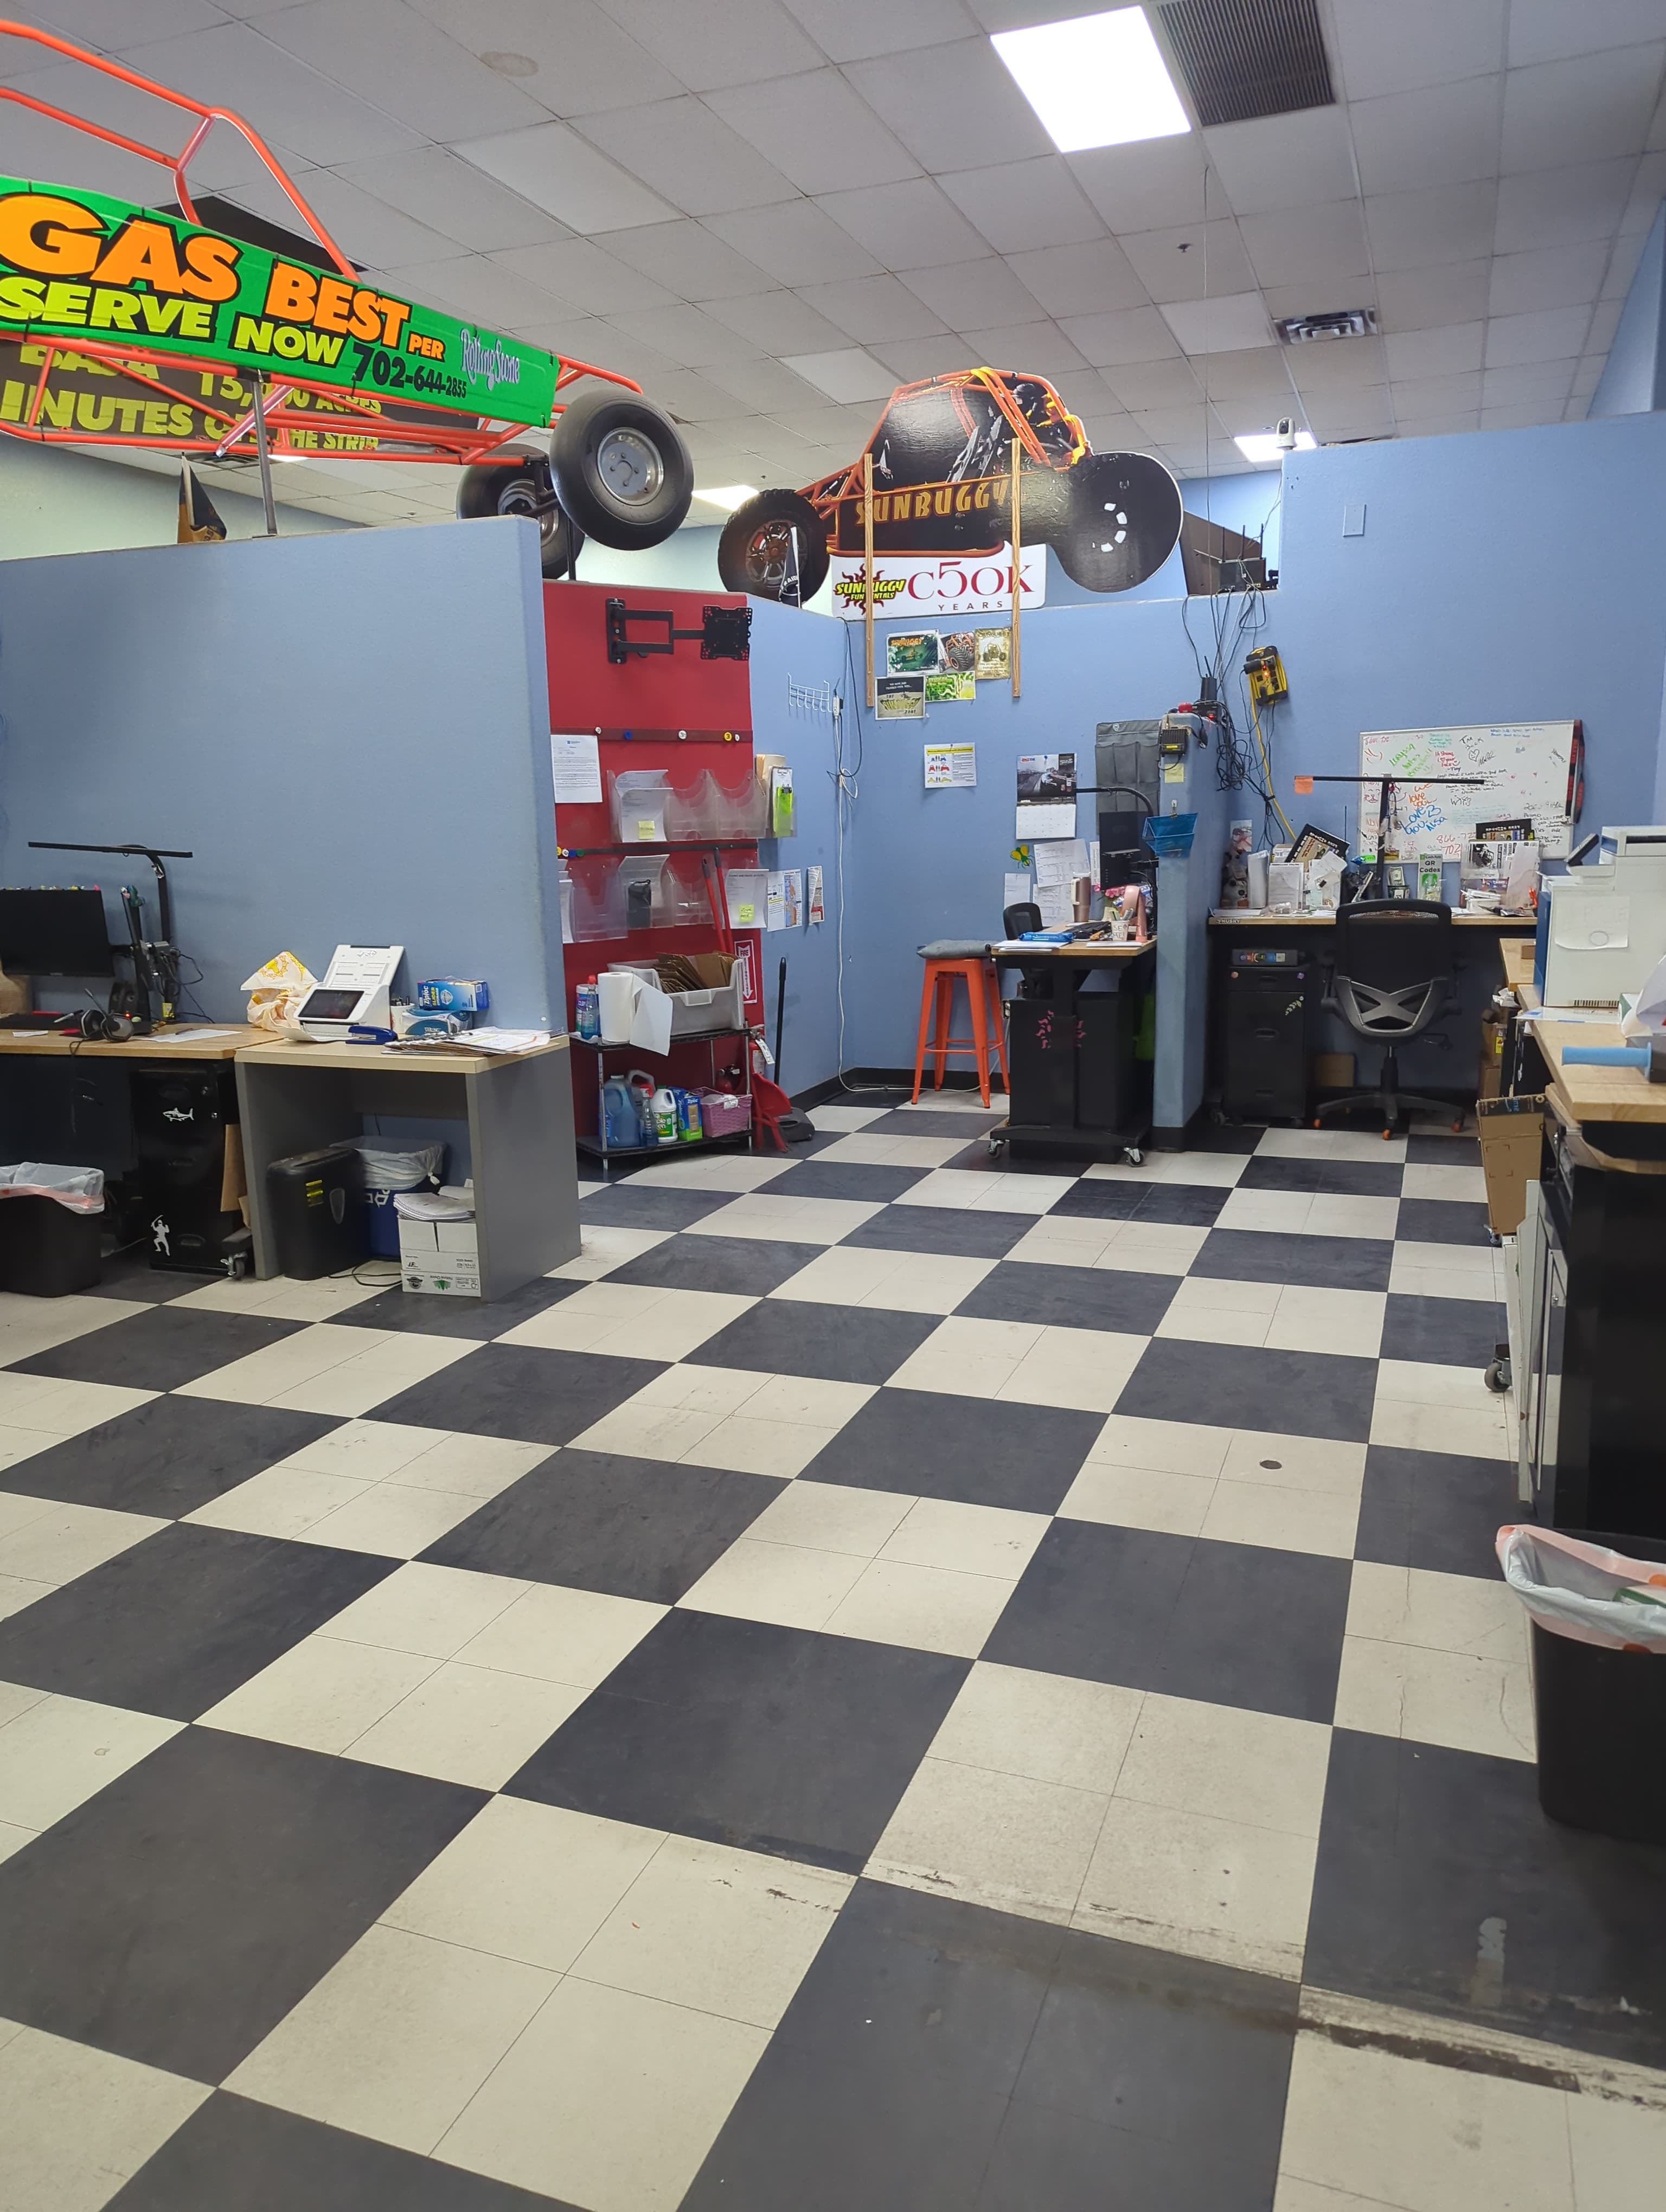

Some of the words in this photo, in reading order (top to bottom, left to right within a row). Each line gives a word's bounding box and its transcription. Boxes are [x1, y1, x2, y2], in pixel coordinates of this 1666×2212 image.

[0, 194, 241, 303] GAS
[265, 261, 412, 348] BEST
[408, 336, 444, 359] PER
[0, 276, 214, 338] SERVE
[234, 317, 344, 365] NOW
[353, 344, 466, 398] 702-644-2855
[938, 601, 1003, 612] YEARS
